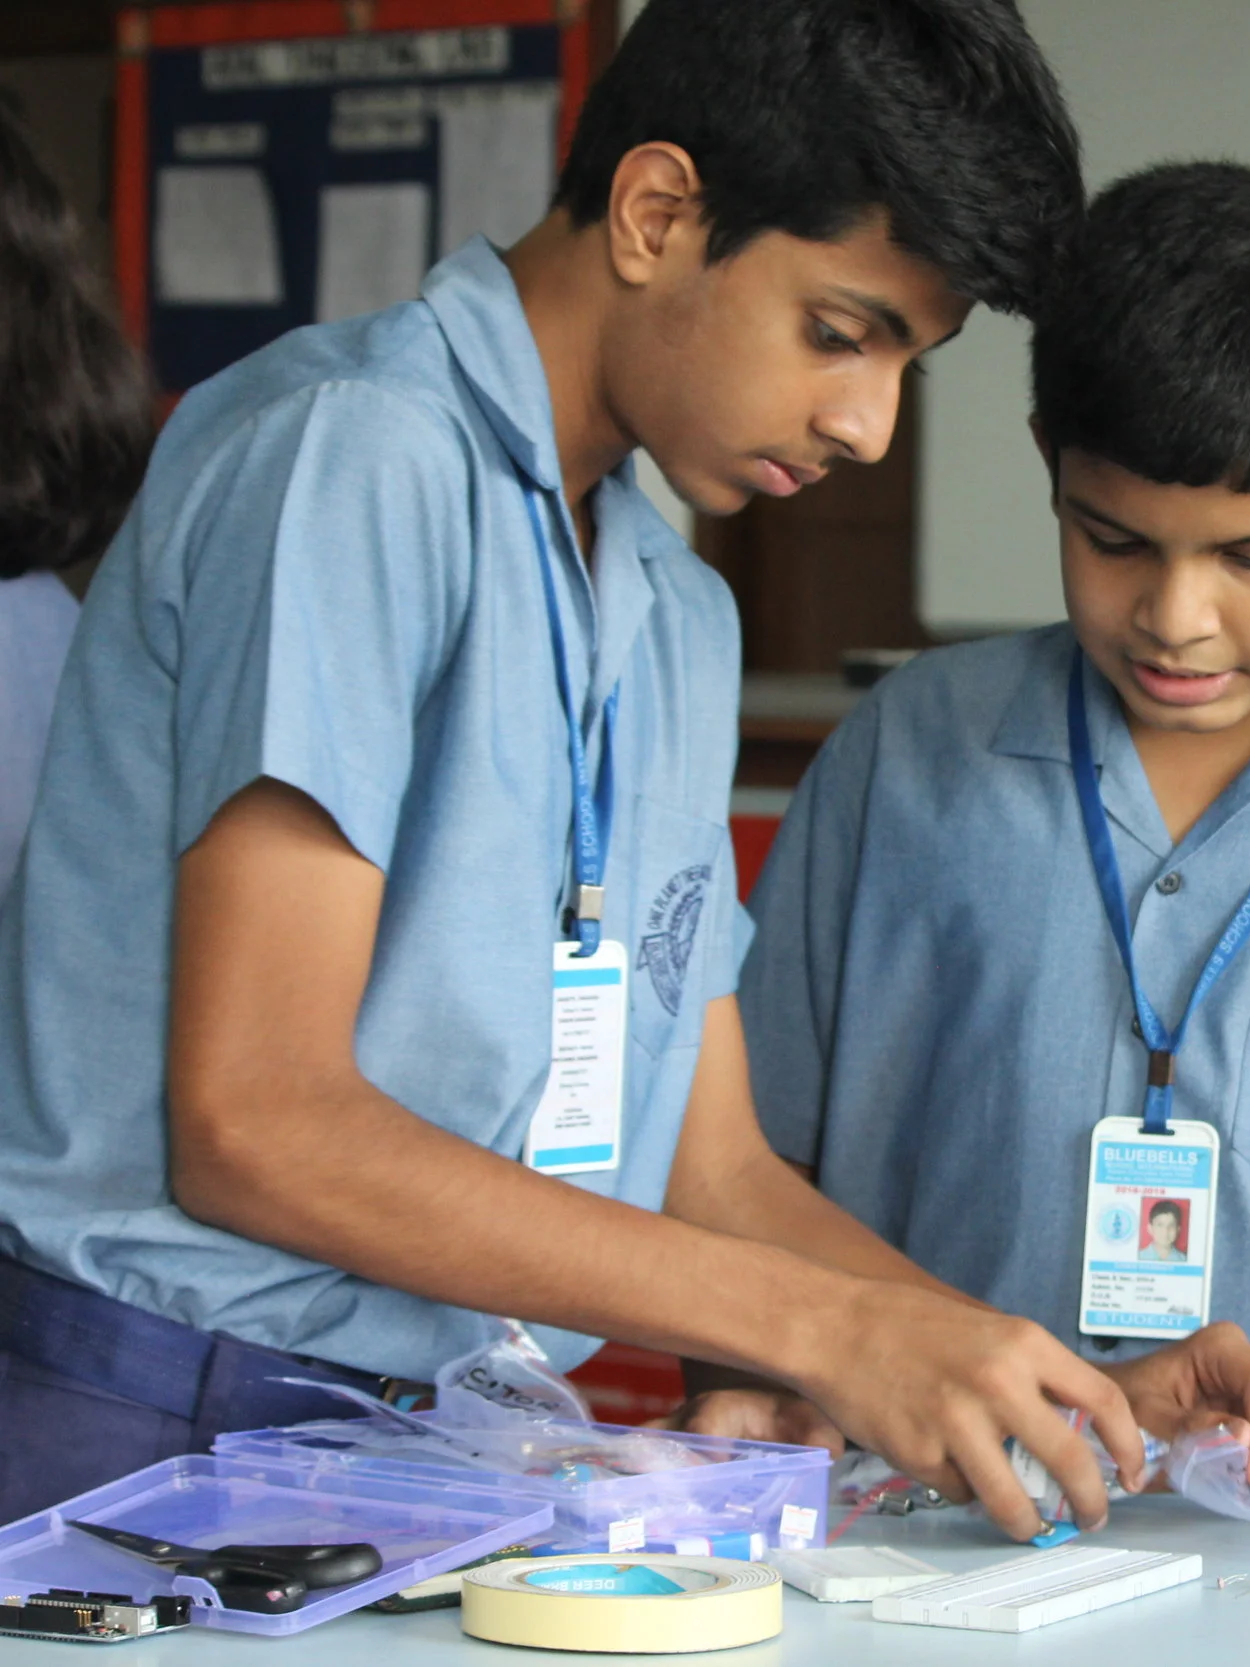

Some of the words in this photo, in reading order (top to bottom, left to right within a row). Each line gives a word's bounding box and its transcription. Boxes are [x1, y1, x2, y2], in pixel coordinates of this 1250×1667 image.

[1103, 1147, 1198, 1166] BLUEBELLS
[1094, 1312, 1185, 1327] STUDENT
[573, 1579, 615, 1590] DEER
